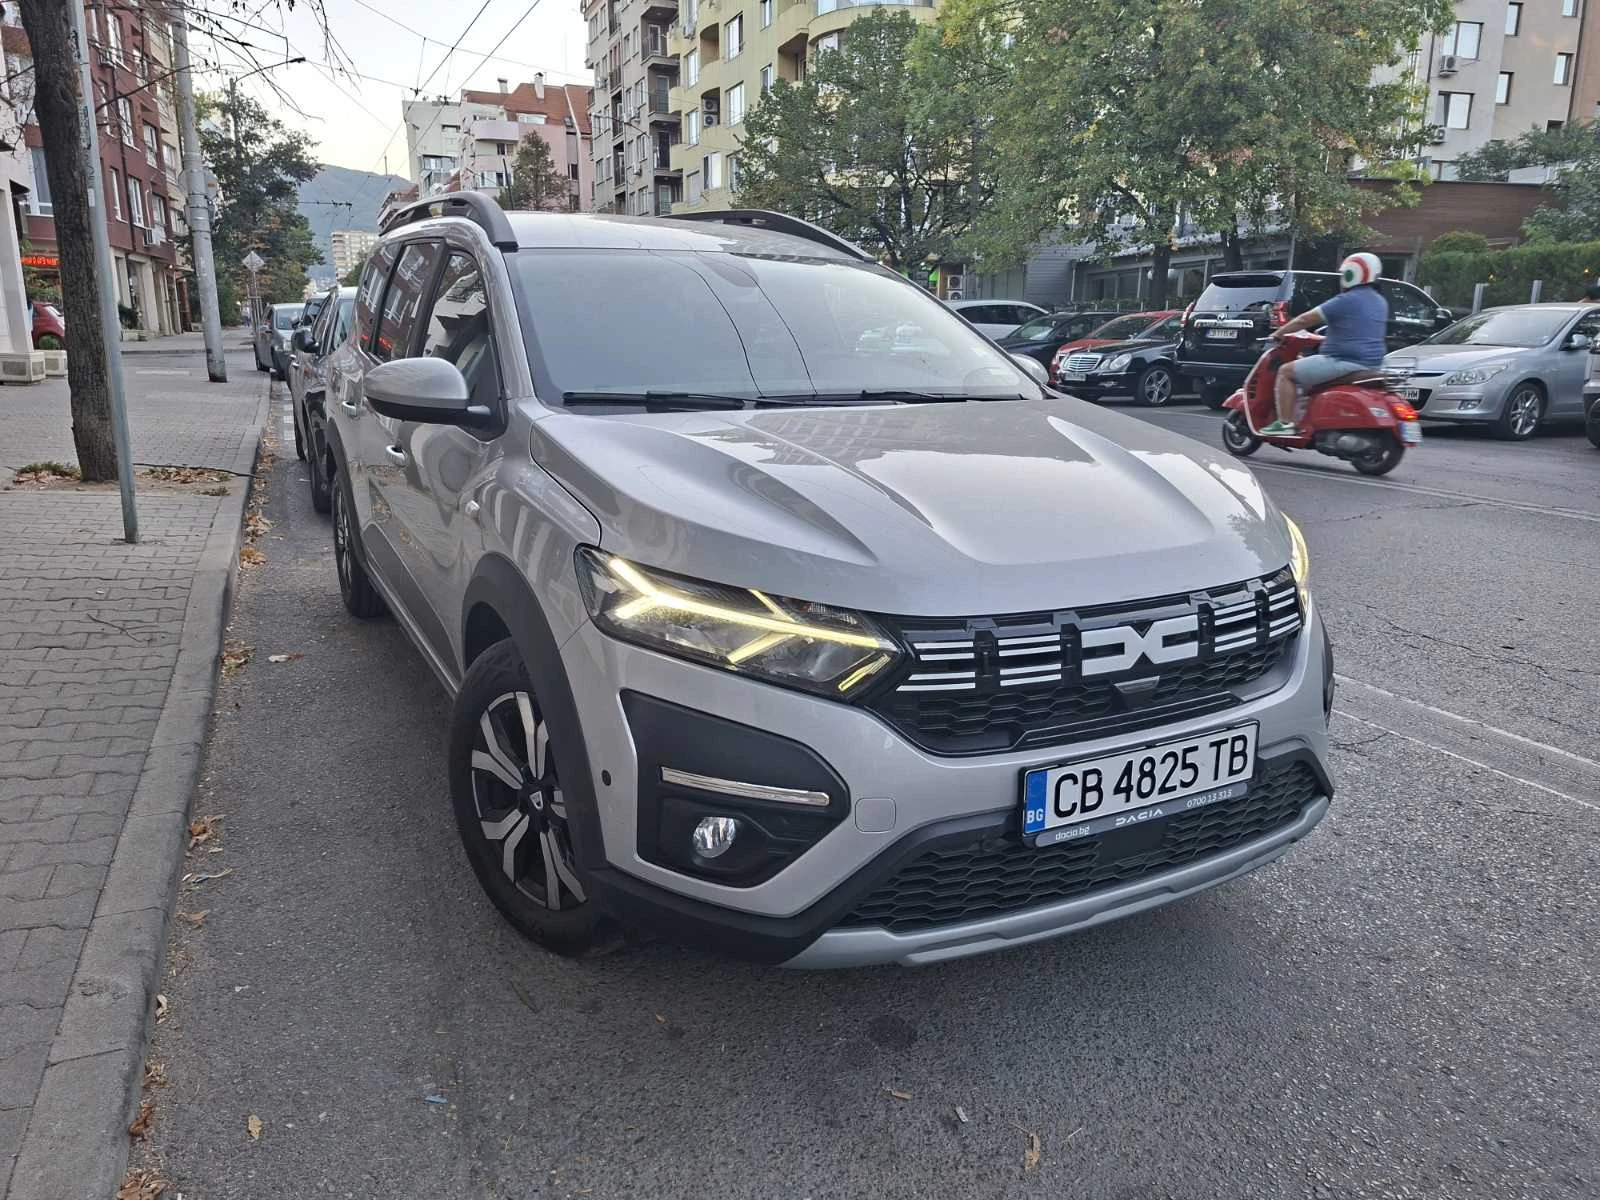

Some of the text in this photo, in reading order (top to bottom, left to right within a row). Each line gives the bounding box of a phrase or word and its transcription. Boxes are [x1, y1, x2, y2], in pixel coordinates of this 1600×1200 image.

[1053, 734, 1248, 818] CB 4825 TB
[1026, 808, 1044, 824] BG
[1115, 808, 1164, 826] DACIA
[1186, 796, 1207, 808] 0700
